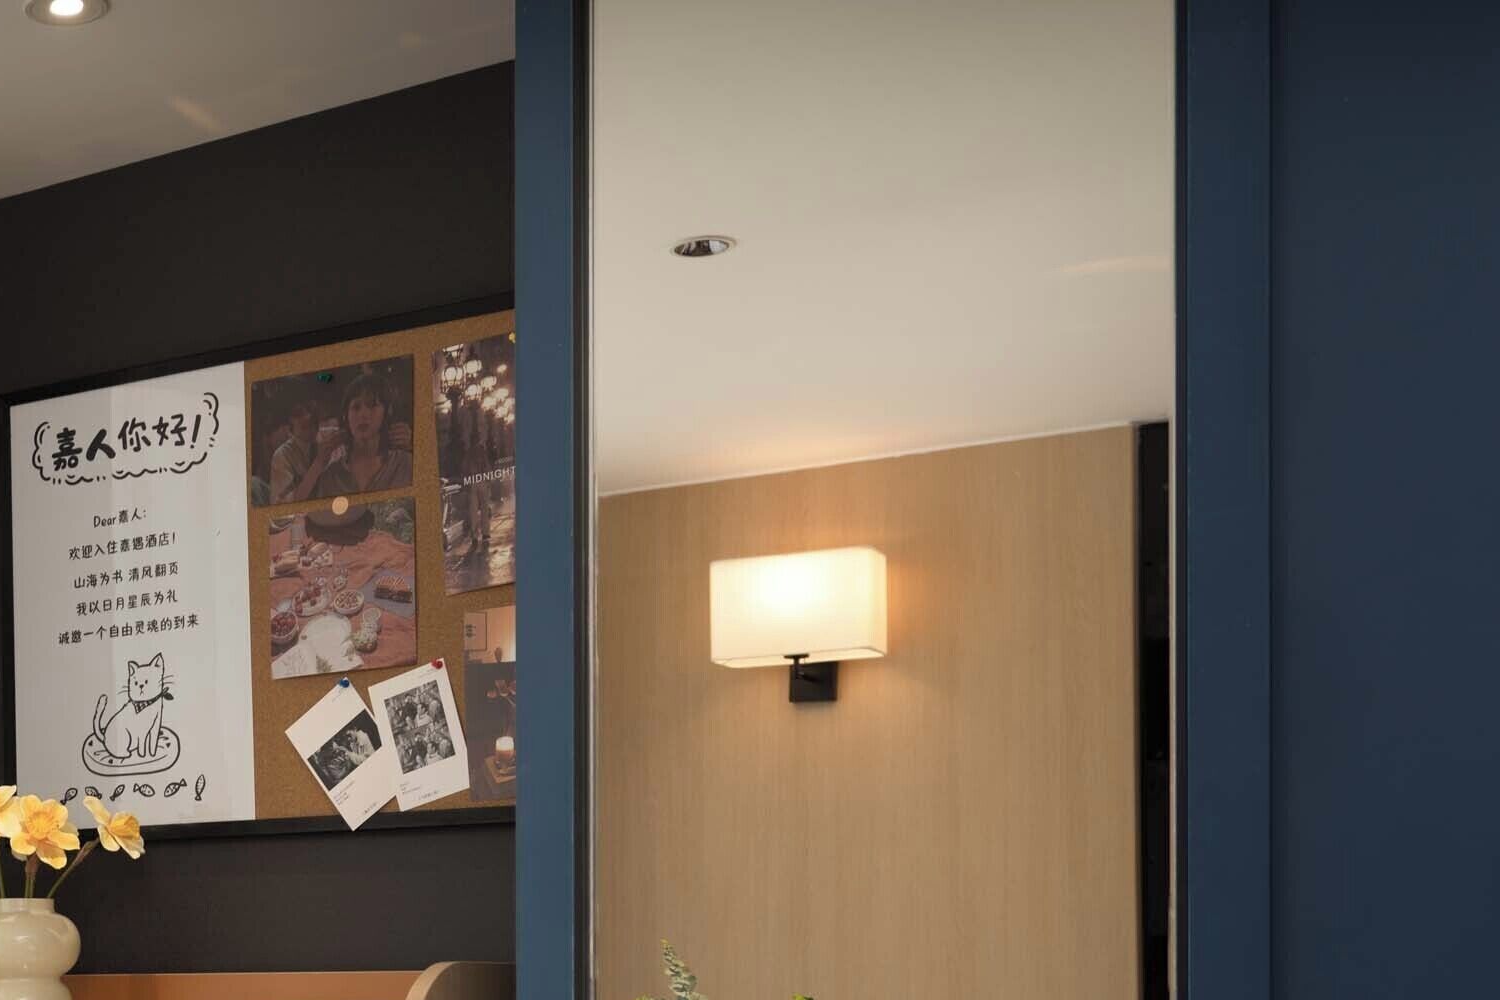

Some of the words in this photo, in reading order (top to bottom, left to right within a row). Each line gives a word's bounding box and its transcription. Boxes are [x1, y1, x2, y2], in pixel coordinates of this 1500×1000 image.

[463, 466, 516, 486] MIDNIGHT
[93, 515, 116, 528] Dear
[74, 569, 123, 589] 山海为书
[128, 561, 179, 582] 清风翻页
[76, 589, 178, 616] 我以日月星辰为礼
[58, 613, 199, 645] 诚邀一个自由灵魂的到来
